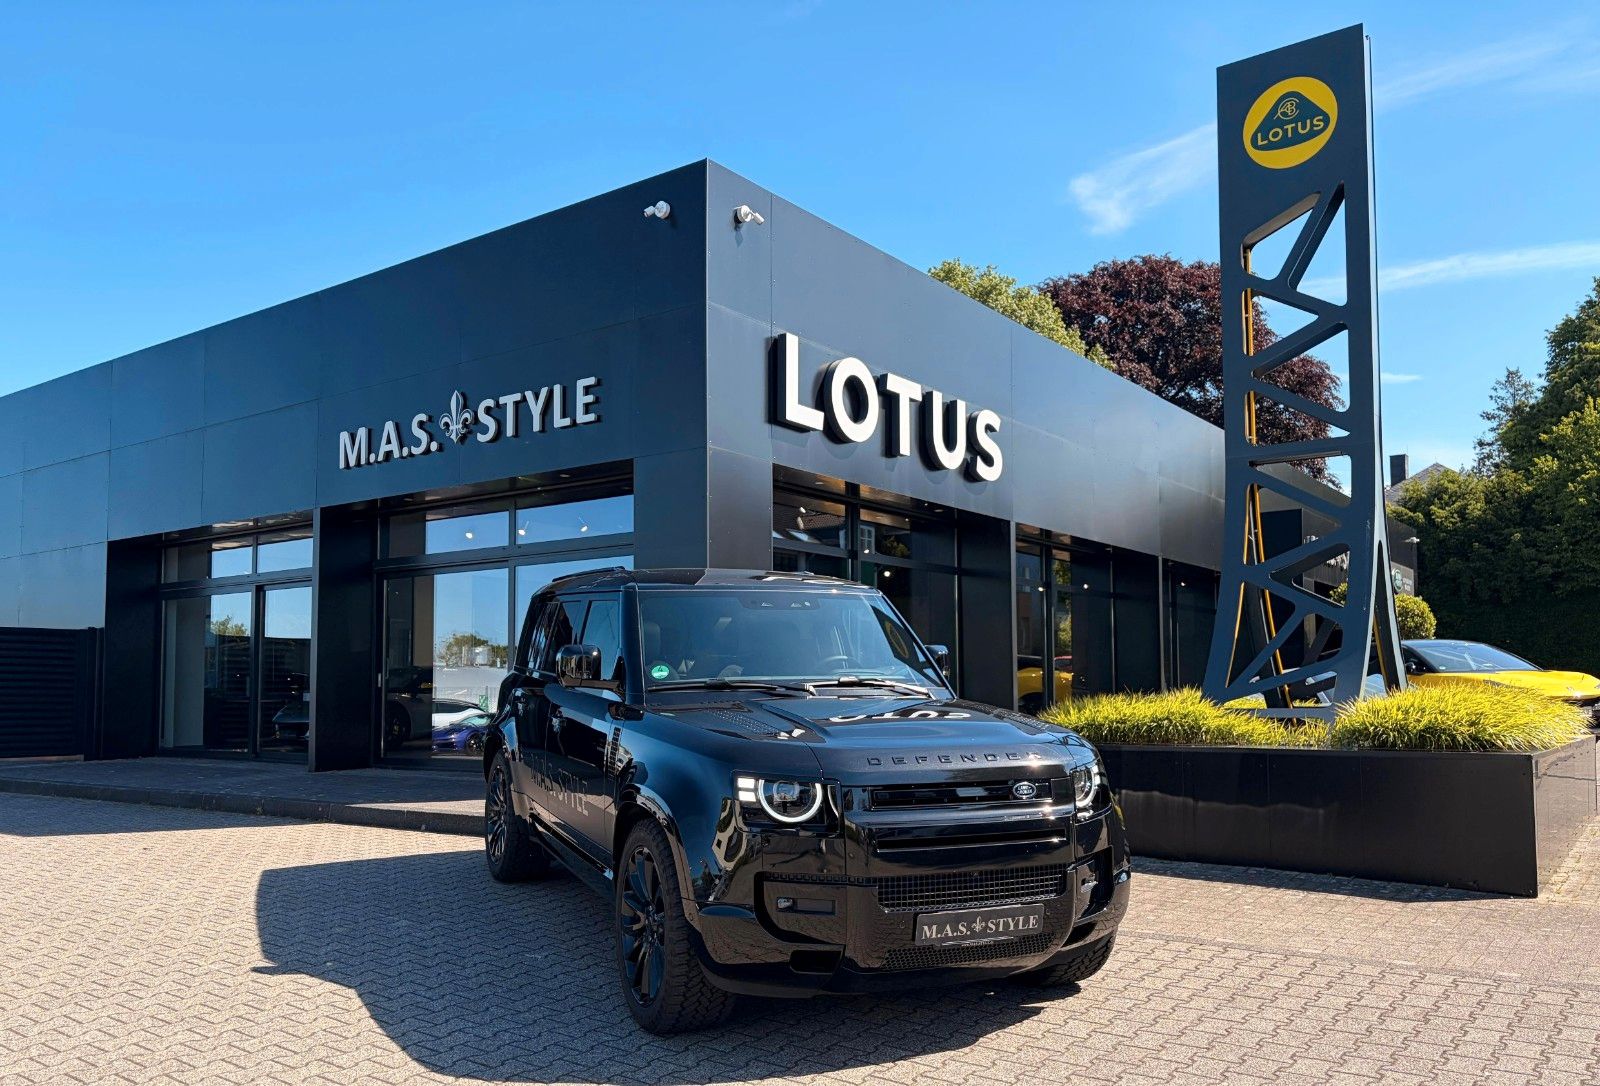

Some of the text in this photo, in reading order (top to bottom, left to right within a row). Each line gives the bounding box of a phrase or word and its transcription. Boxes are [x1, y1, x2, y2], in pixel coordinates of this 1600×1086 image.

[1257, 115, 1325, 146] LOTUS
[339, 376, 598, 469] M.A.S. STYLE
[779, 332, 1003, 482] LOTUS
[921, 915, 1039, 940] M.A.S. STYLE
